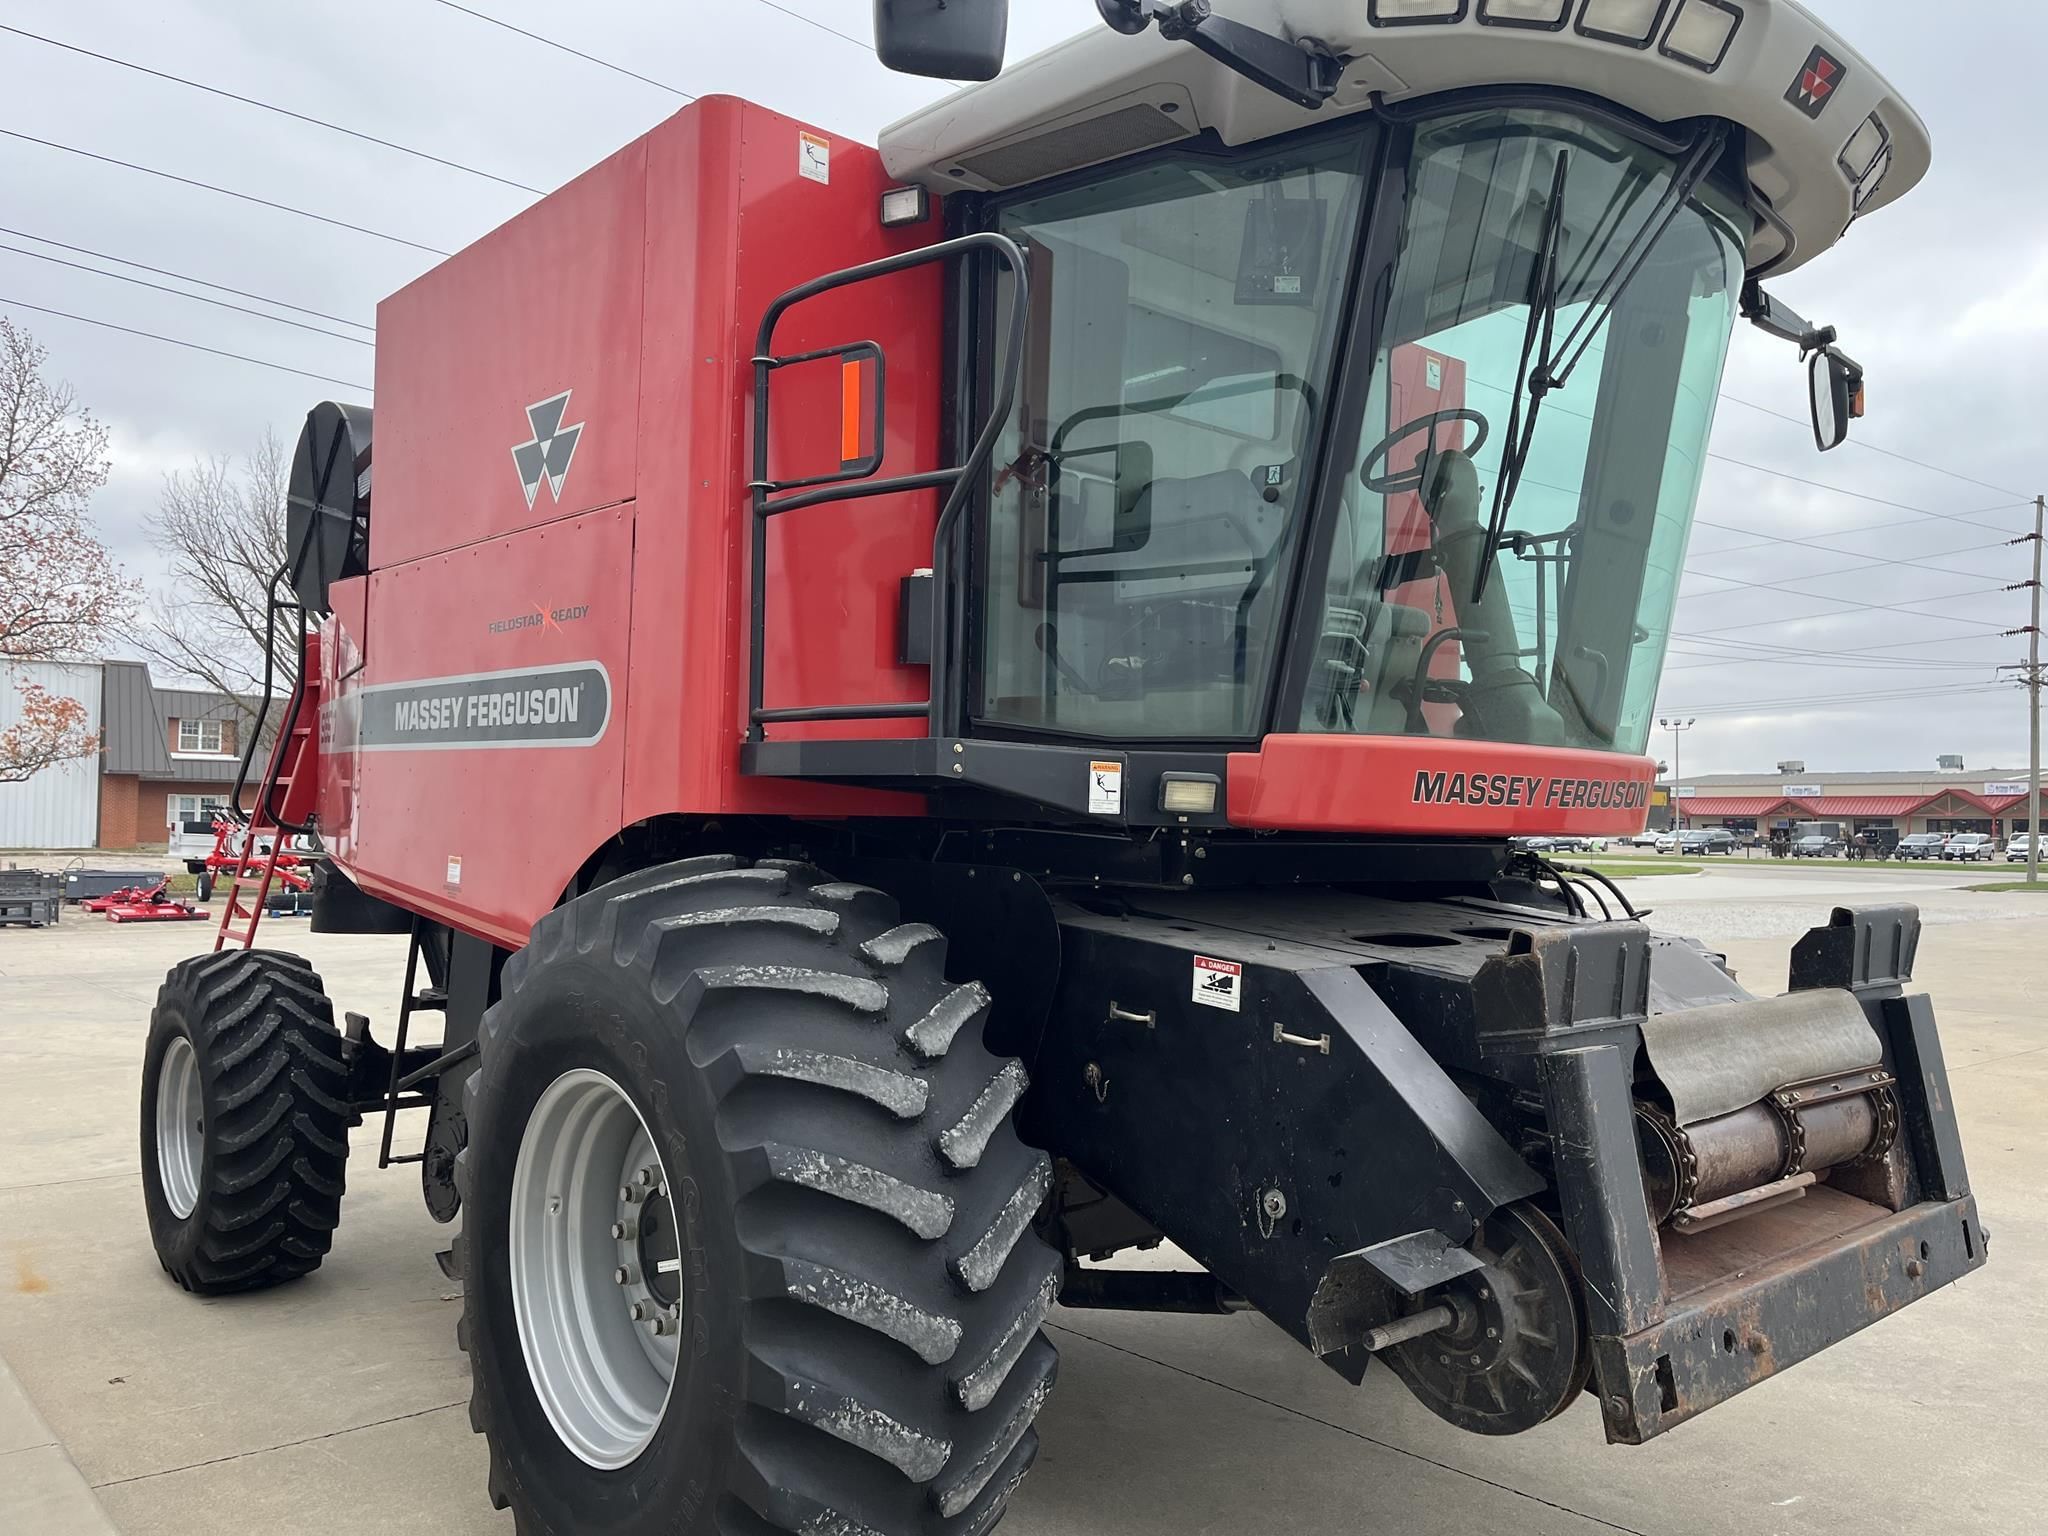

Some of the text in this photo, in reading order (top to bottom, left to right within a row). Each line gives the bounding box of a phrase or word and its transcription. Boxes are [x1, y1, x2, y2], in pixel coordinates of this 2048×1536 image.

[488, 605, 589, 634] FIELDSTAR READY
[394, 687, 579, 732] MASSEY FERGUSON
[1411, 769, 1650, 810] MASSEY FERGUSON
[1208, 961, 1235, 973] DANGER
